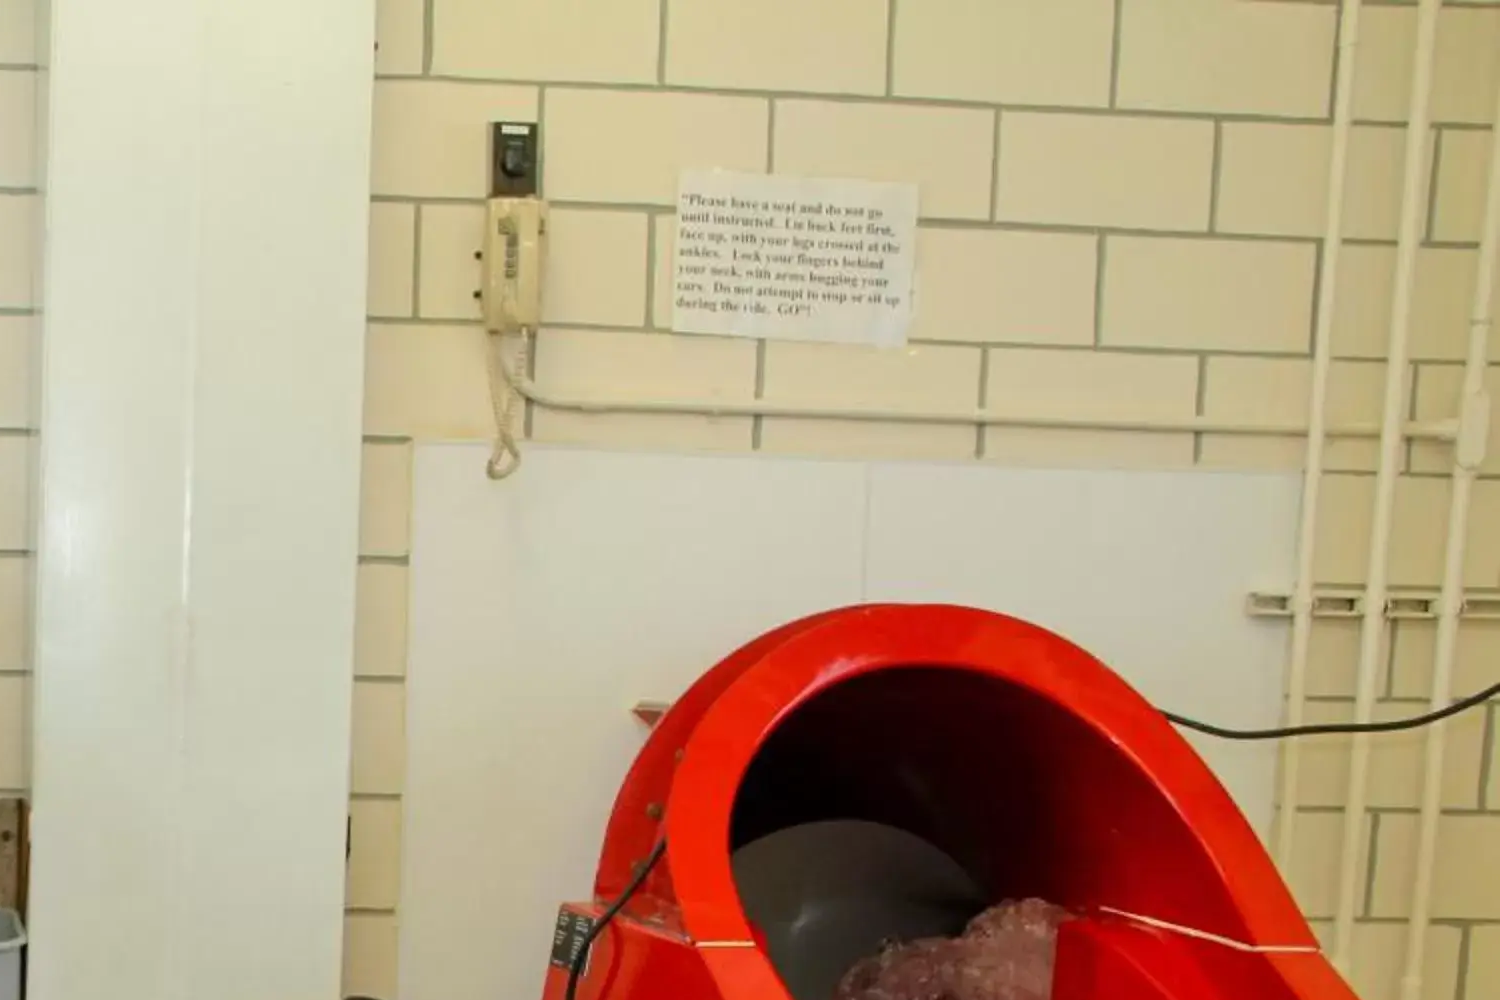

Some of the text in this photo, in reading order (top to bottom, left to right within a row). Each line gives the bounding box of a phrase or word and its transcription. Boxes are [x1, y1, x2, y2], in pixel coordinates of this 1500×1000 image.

[731, 196, 757, 209] have
[762, 200, 768, 210] a
[773, 199, 795, 212] seat
[800, 202, 822, 214] and
[825, 203, 841, 215] do
[844, 205, 864, 216] not
[868, 208, 883, 219] go
[681, 212, 709, 223] until
[808, 219, 836, 232] back
[841, 221, 863, 234] feet
[679, 229, 704, 241] face
[731, 231, 757, 243] with
[760, 235, 790, 248] your
[792, 235, 815, 250] legs
[817, 238, 864, 252] crossed
[867, 242, 879, 253] at
[882, 242, 900, 254] the
[733, 248, 761, 261] Lock
[765, 253, 793, 265] your
[797, 253, 839, 269] fingers
[842, 255, 885, 269] behind
[678, 264, 706, 276] your
[746, 268, 771, 280] with
[775, 271, 805, 282] arms
[809, 271, 859, 288] hugging
[862, 277, 889, 288] your
[676, 297, 716, 312] during
[721, 298, 739, 311] the
[713, 282, 733, 294] Do
[734, 284, 753, 295] not
[756, 285, 803, 302] attempt
[807, 288, 818, 300] to
[822, 290, 847, 304] stop
[851, 293, 863, 303] or
[867, 291, 881, 304] sit
[885, 295, 900, 308] up
